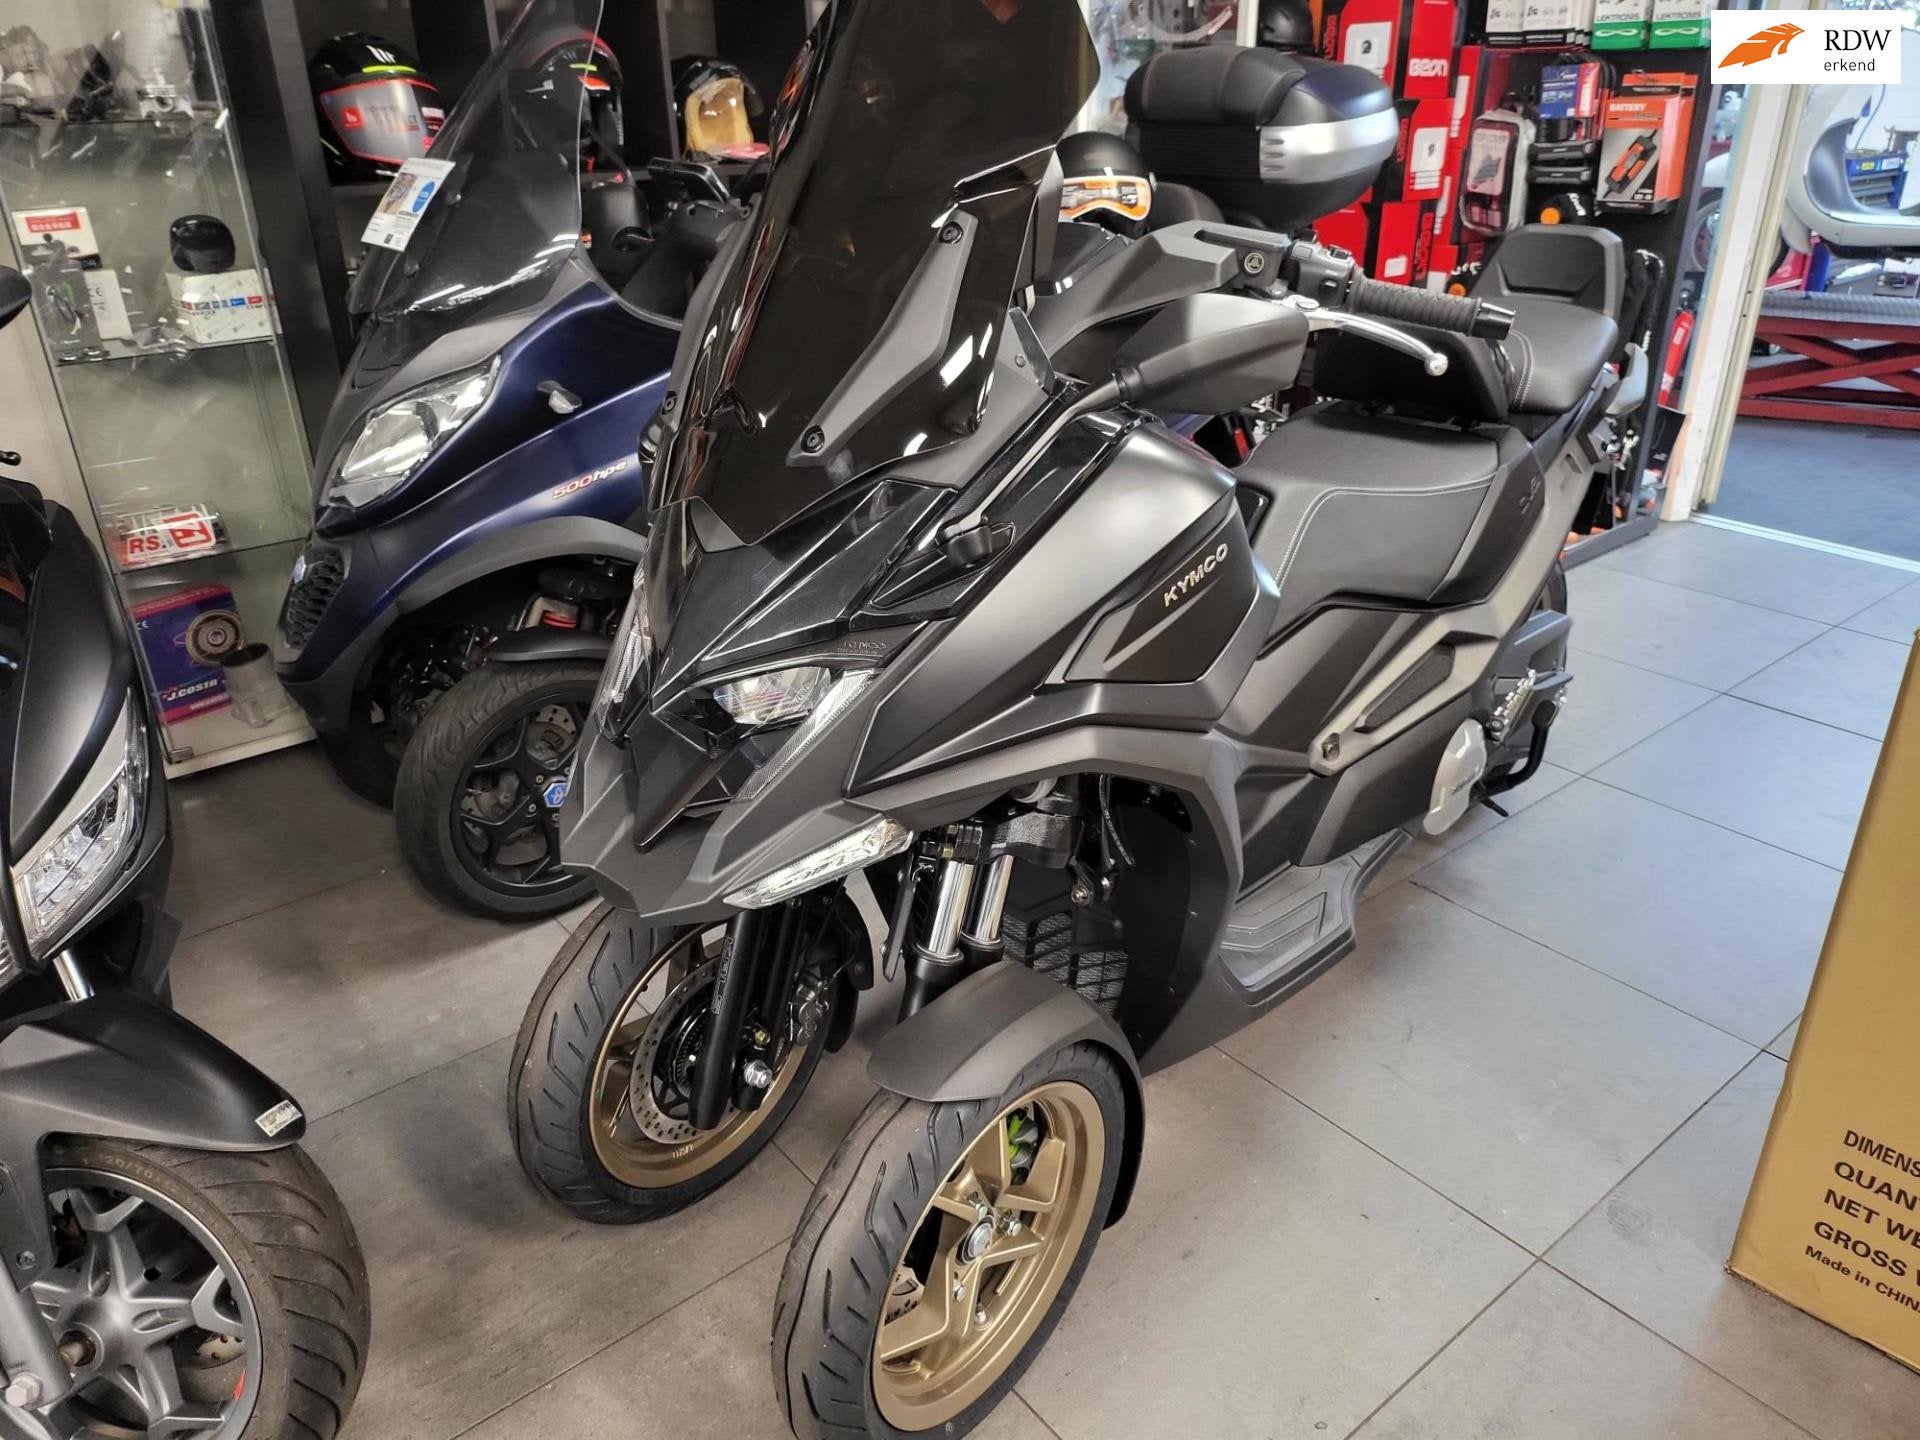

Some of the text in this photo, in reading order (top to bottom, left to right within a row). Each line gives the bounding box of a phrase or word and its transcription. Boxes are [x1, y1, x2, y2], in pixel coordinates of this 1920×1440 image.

[1164, 543, 1228, 608] KYMCO
[1843, 1130, 1920, 1178] DIMENS
[1824, 1189, 1880, 1224] NET
[1834, 1161, 1920, 1211] QUAN
[1814, 1221, 1907, 1277] GROSS
[1805, 1245, 1920, 1314] Made in CHIN
